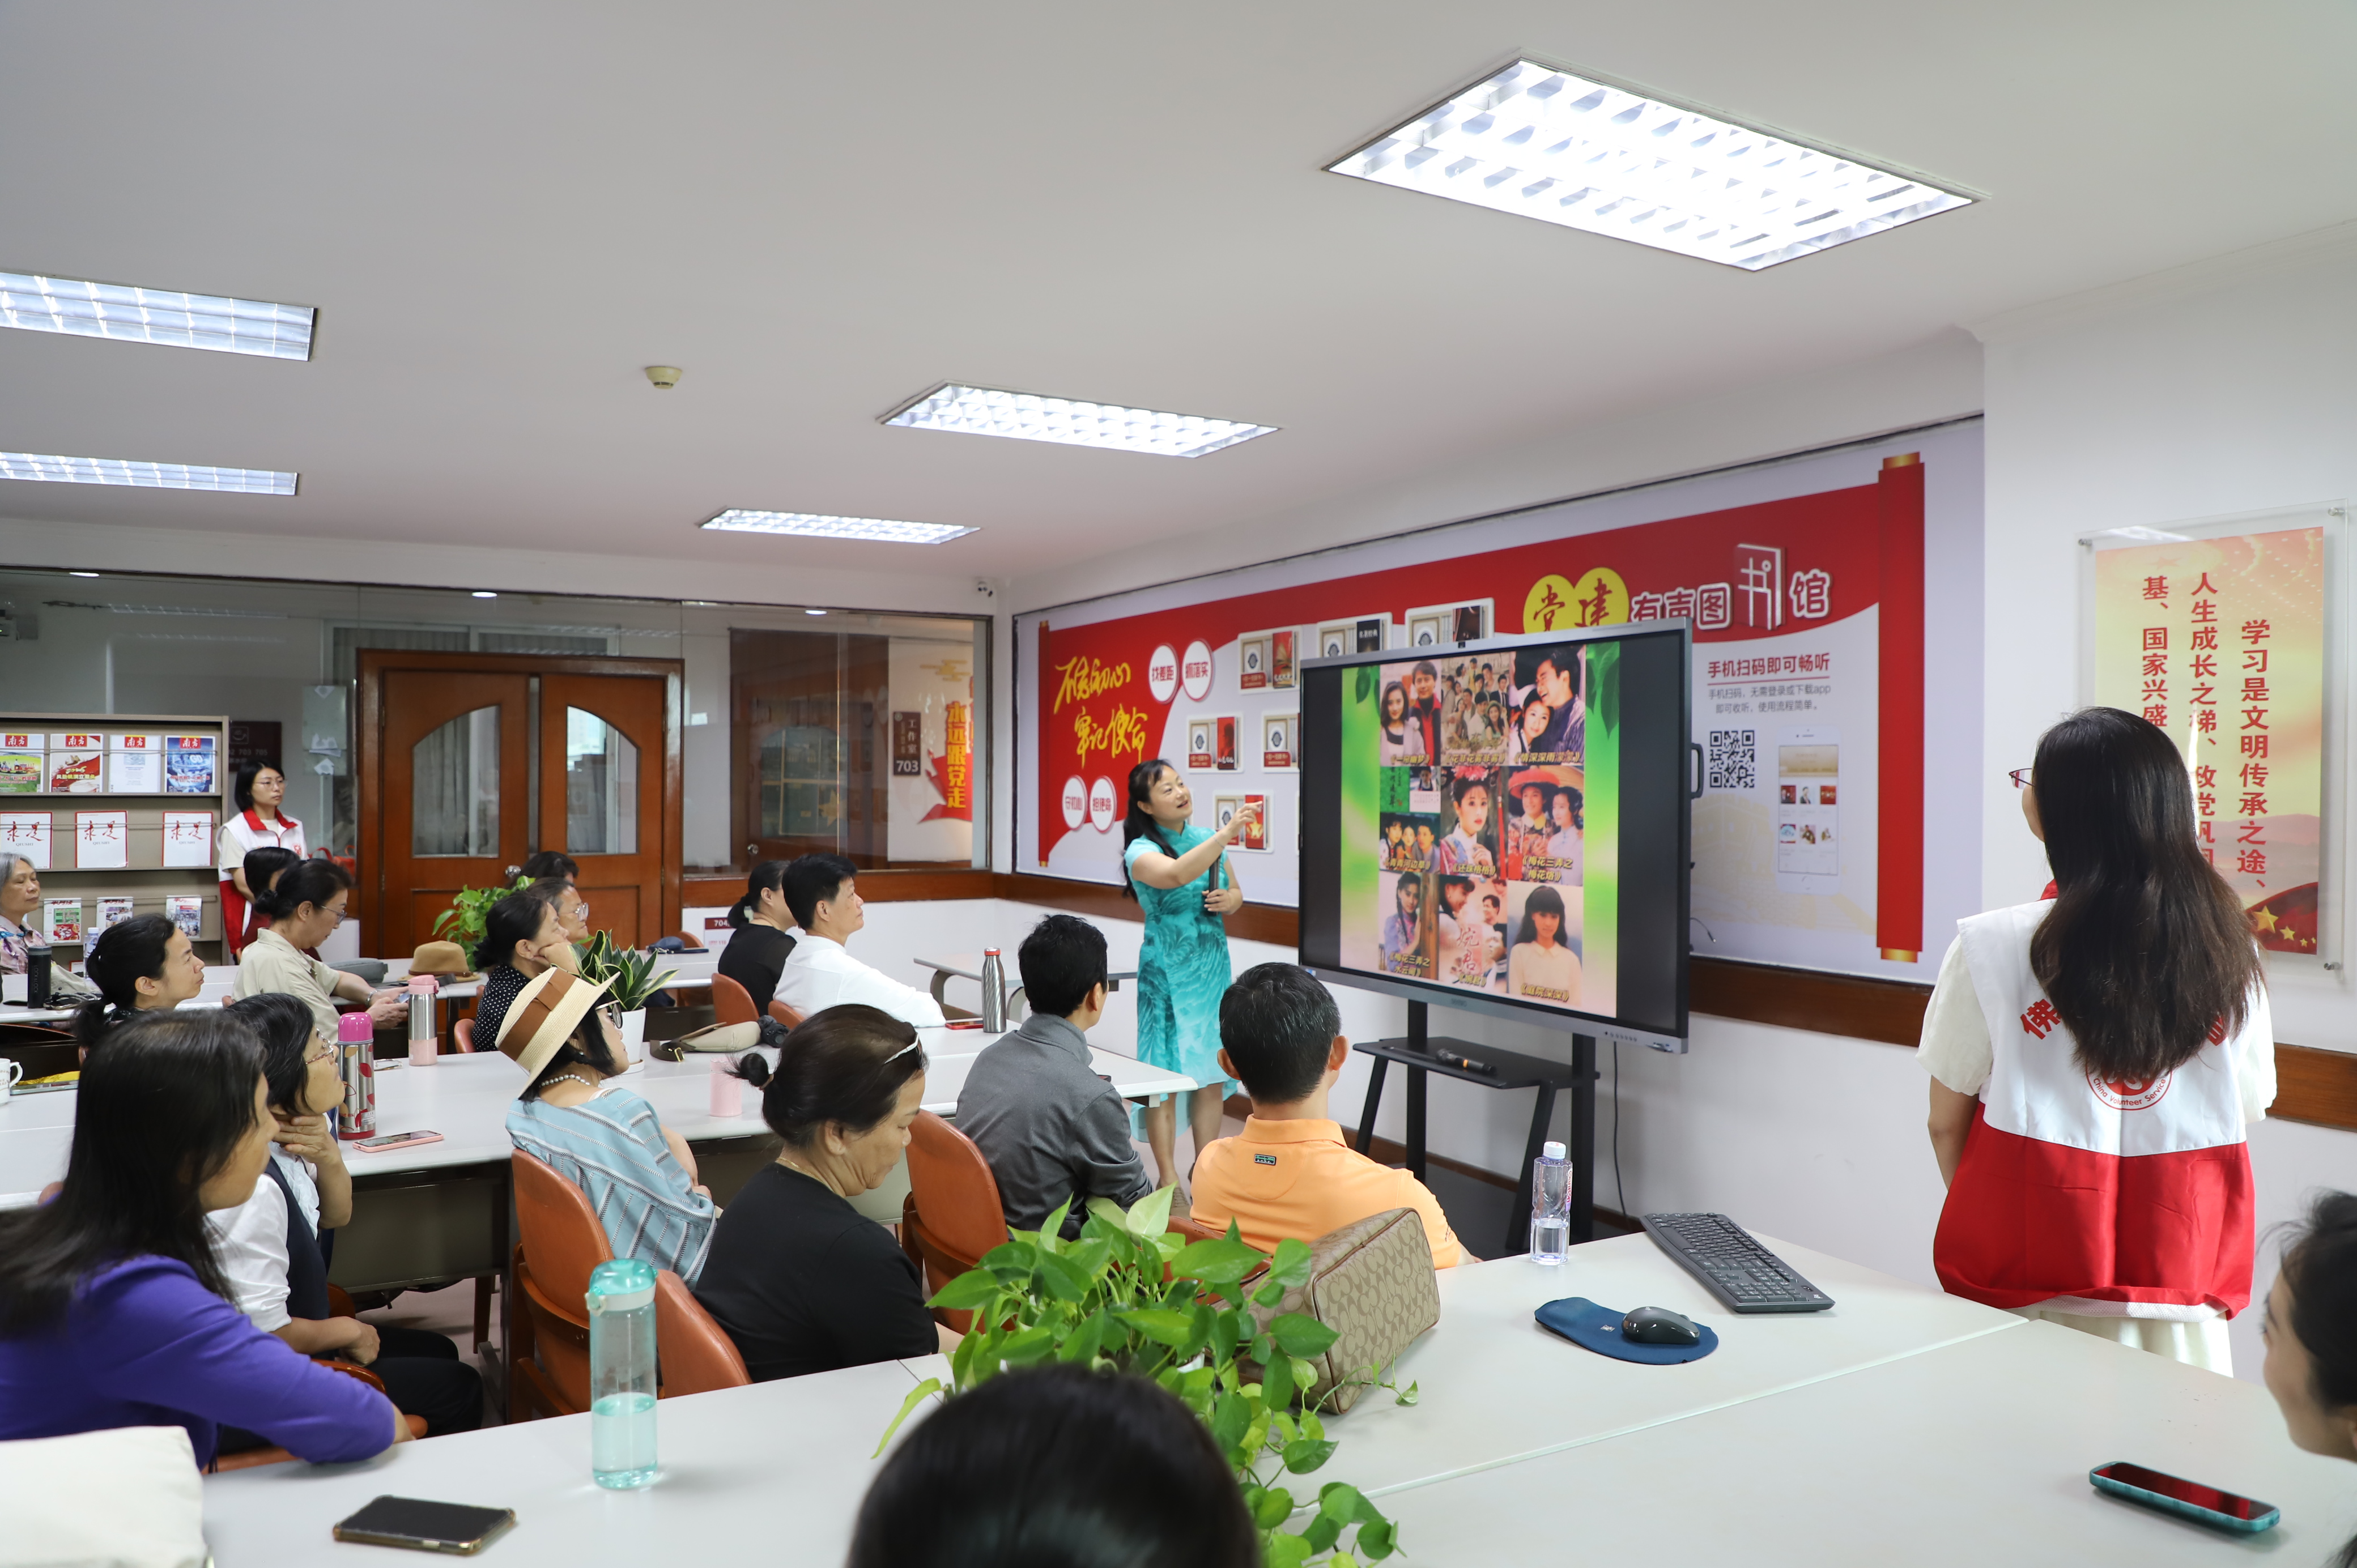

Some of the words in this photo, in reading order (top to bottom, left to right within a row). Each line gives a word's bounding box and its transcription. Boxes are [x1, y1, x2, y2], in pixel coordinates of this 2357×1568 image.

[1185, 661, 1209, 679] 抓落实
[1708, 653, 1830, 679] 手机扫码即可畅听
[1053, 655, 1131, 715] 不忘初心
[8, 735, 25, 746] 南方
[68, 735, 86, 746] 南方
[127, 737, 143, 747] 南方
[182, 738, 198, 747] 南方
[1074, 703, 1148, 770] 牢记使命
[946, 700, 967, 808] 永远跟党走
[2237, 619, 2270, 888] 学习是文明传承之途、
[896, 760, 919, 773] 703
[1092, 798, 1112, 812] 担使命
[1522, 855, 1573, 869] 《梅花三弄之
[1452, 863, 1497, 876] 《还珠格格》
[1528, 869, 1562, 882] 梅花烙》
[1389, 952, 1431, 967] 《梅花三弄之
[1520, 982, 1570, 1003] 《庭院深深》
[2094, 1078, 2108, 1098] China
[2109, 1095, 2142, 1106] Volunteer
[2144, 1079, 2166, 1102] Service
